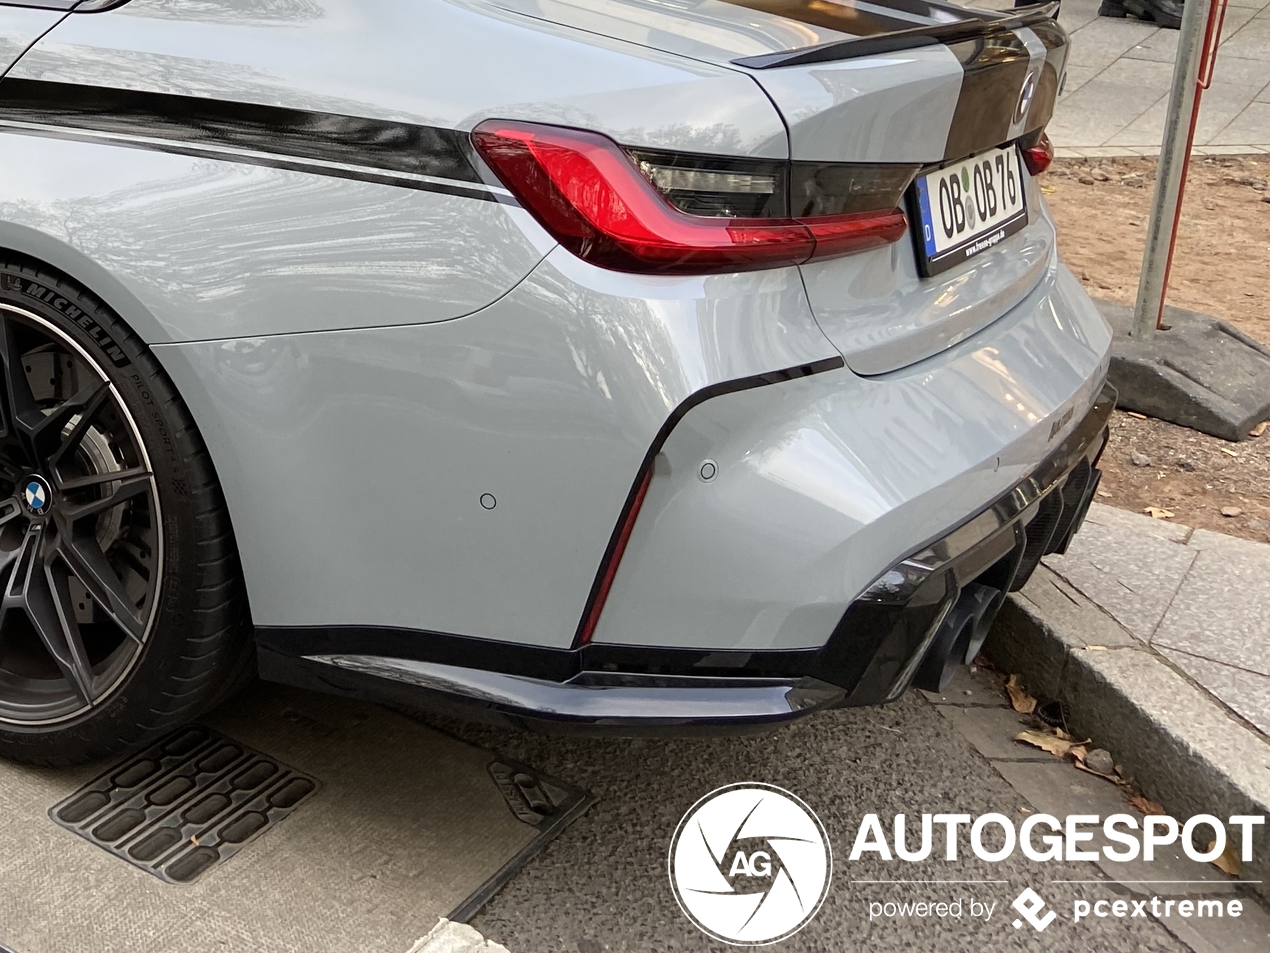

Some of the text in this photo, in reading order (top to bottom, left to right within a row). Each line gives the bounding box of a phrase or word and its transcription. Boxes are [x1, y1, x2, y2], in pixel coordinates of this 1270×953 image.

[924, 151, 1016, 242] D OB OB 76
[25, 283, 127, 363] MICHELIN
[131, 373, 155, 406] PILOT
[152, 411, 174, 454] SPORT
